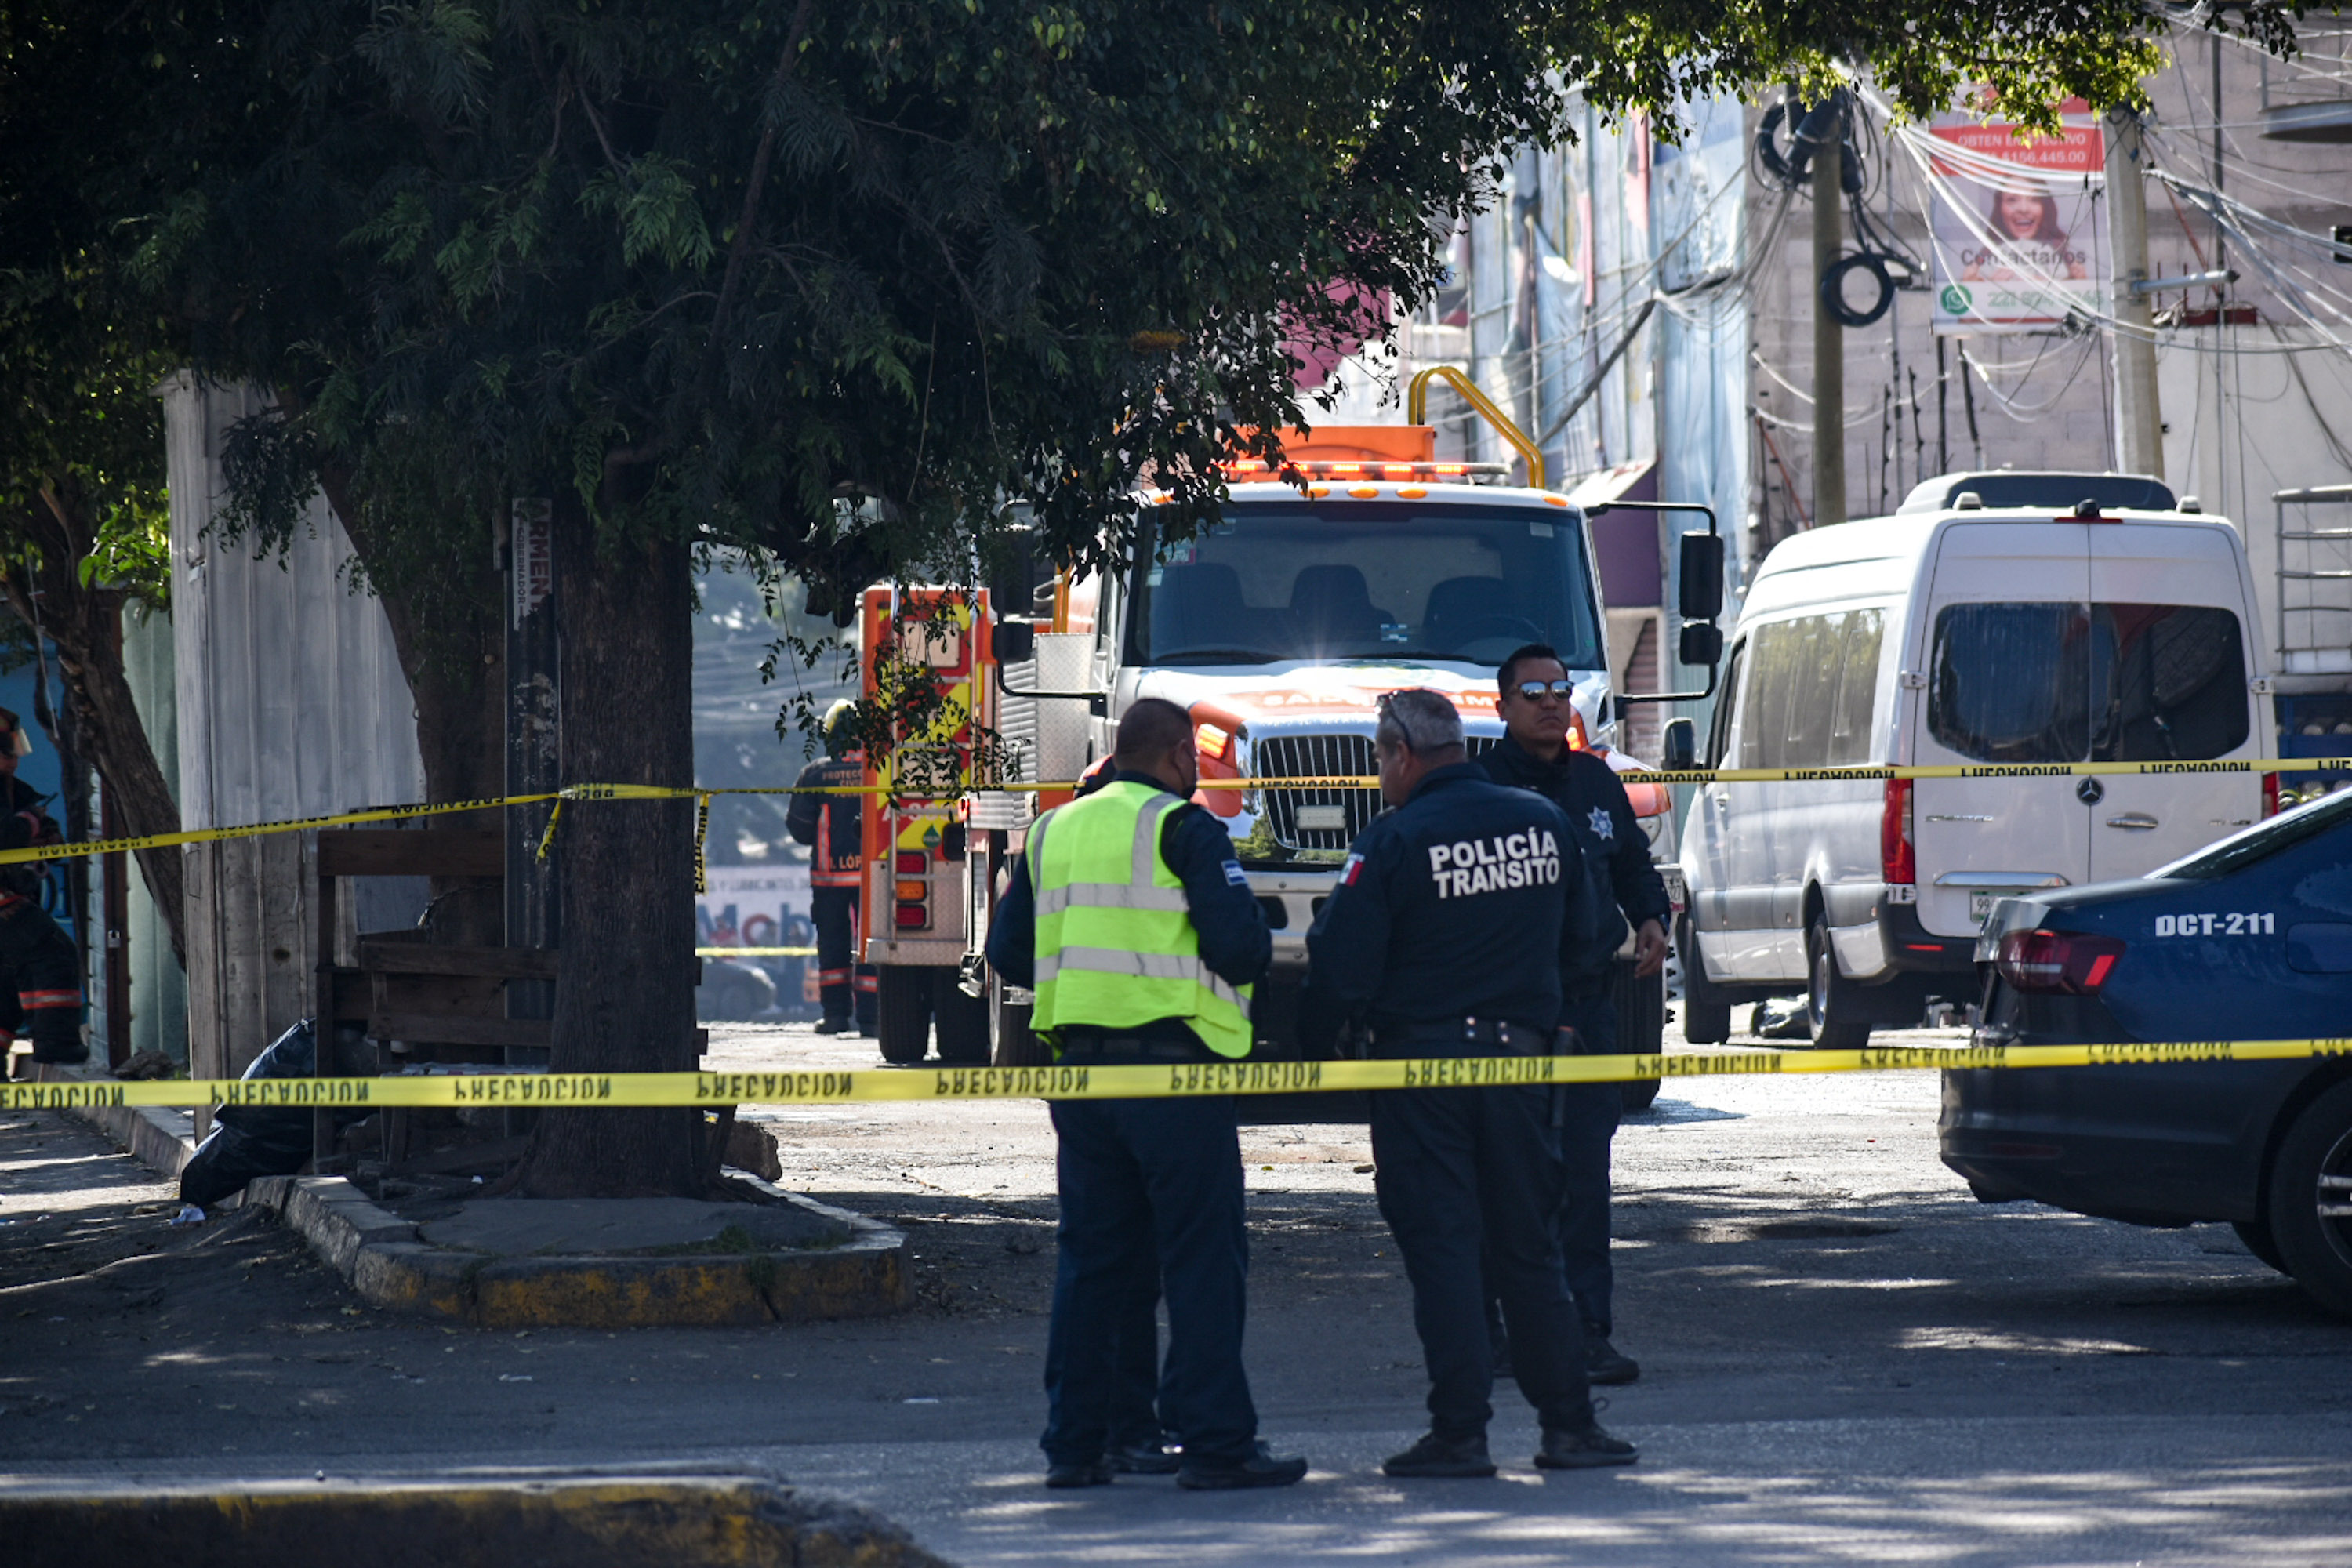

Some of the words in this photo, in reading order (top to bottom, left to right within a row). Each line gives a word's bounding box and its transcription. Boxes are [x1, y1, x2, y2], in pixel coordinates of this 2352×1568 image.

[1958, 134, 2001, 147] OBTEN
[516, 527, 525, 605] GOBERNADOR
[1428, 826, 1560, 872] POLICÍA
[1432, 857, 1560, 899] TRANSITO
[2155, 913, 2274, 937] DCT-211
